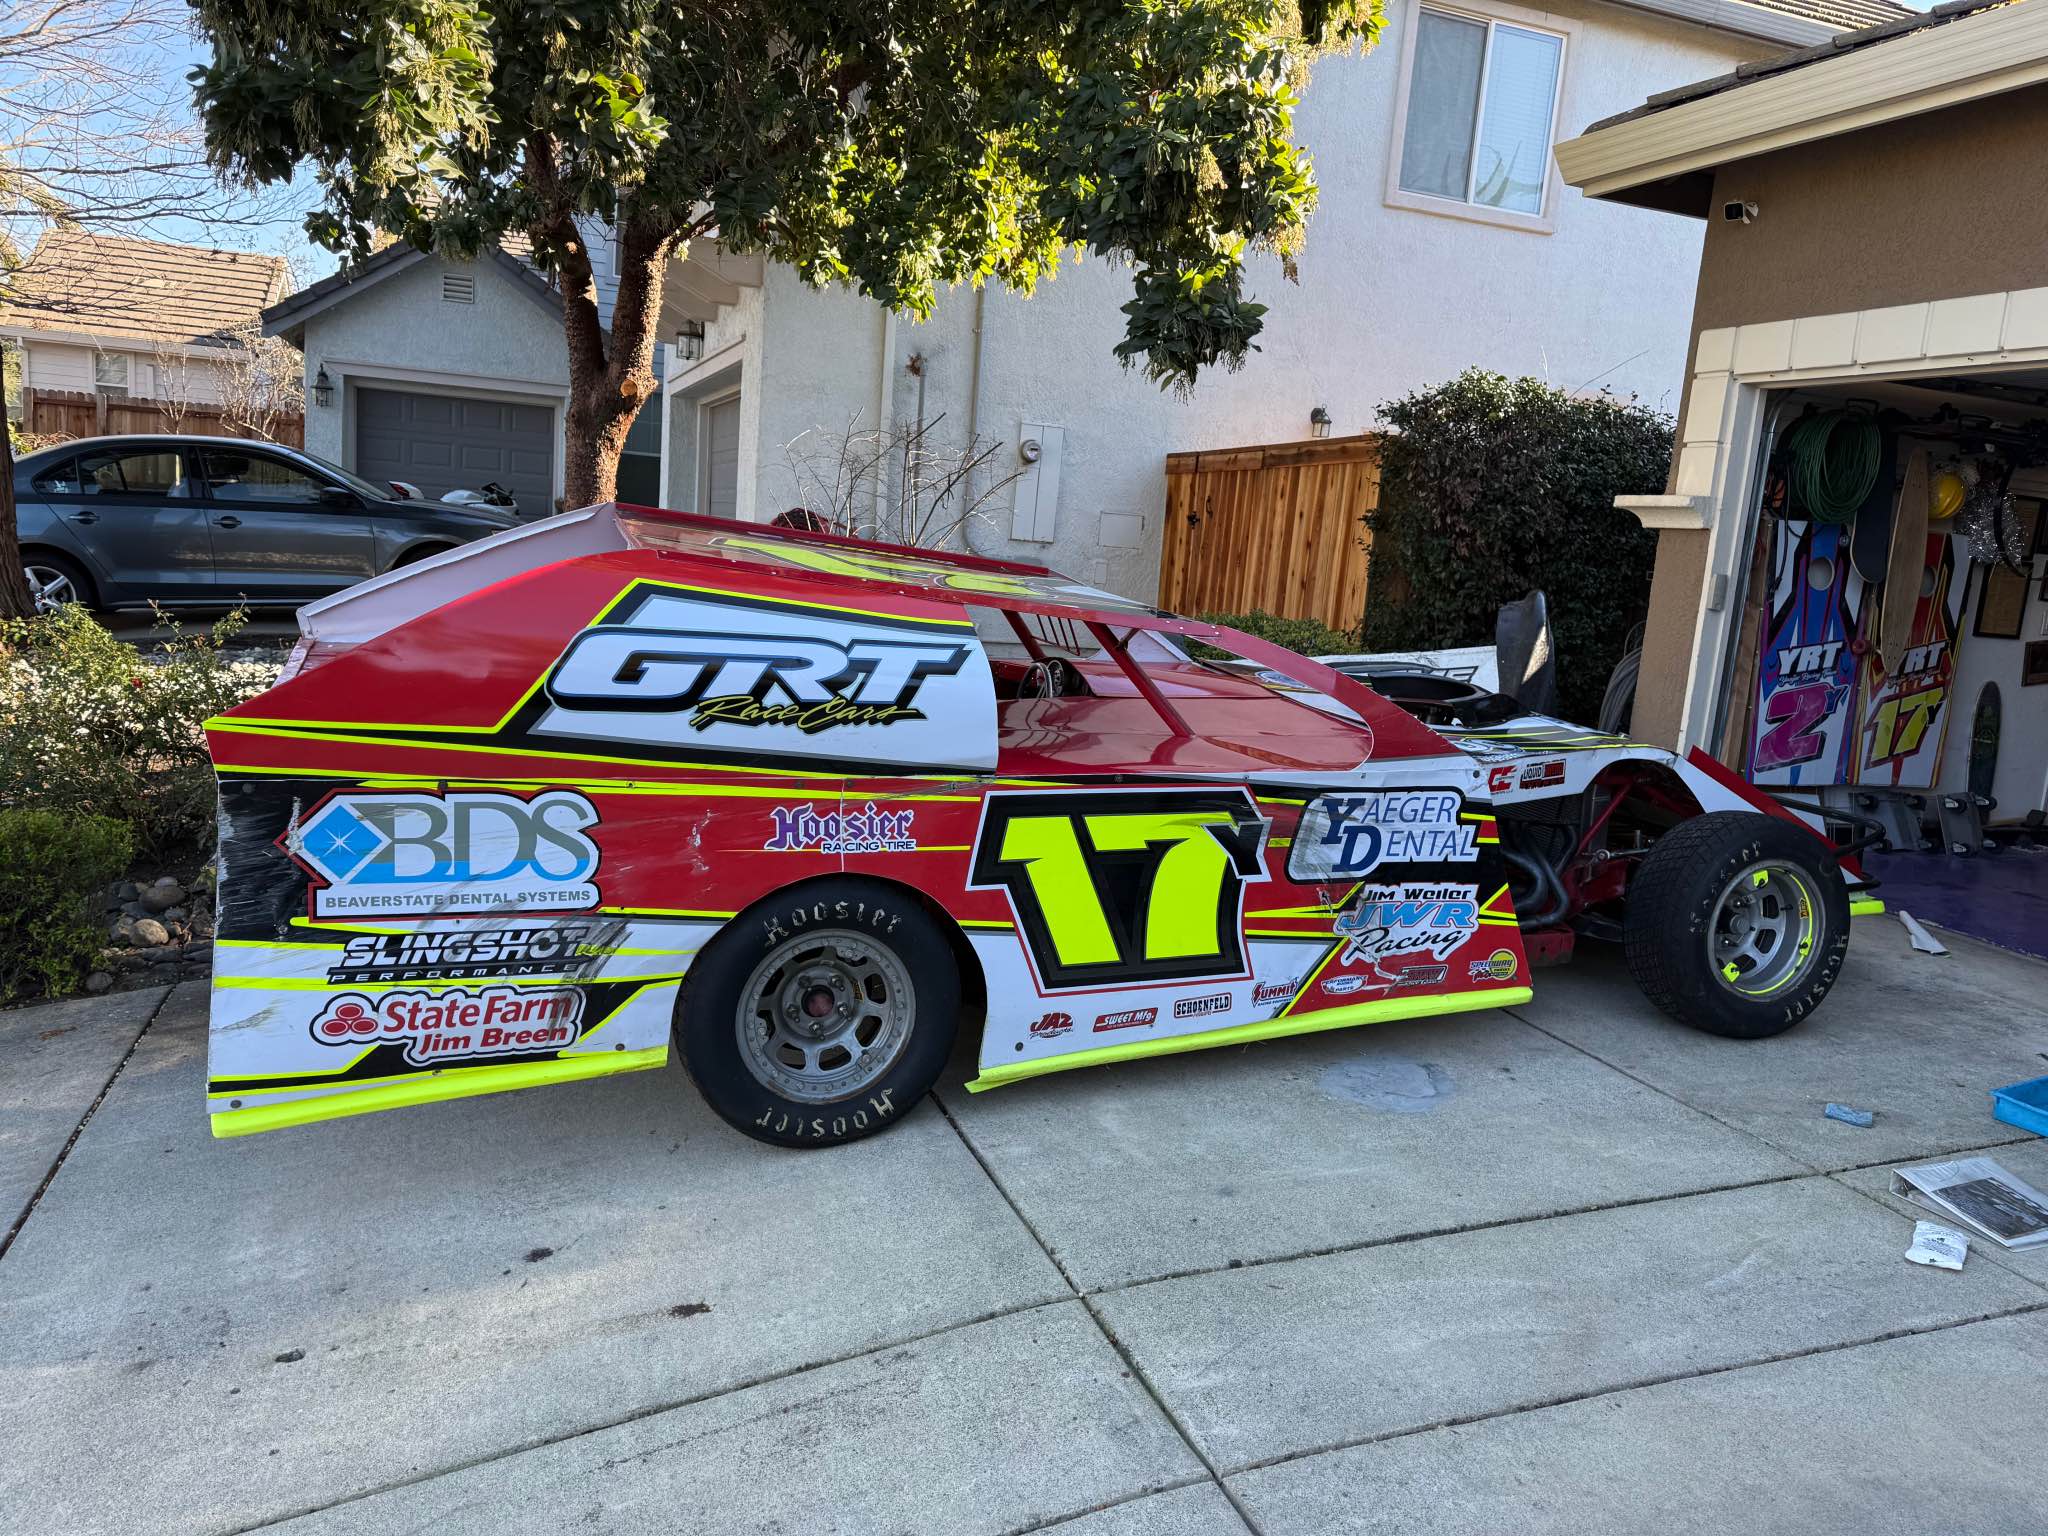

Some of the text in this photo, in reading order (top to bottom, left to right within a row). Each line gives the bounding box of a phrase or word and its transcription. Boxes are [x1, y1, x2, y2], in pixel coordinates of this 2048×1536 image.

[548, 631, 966, 707] GRT
[1778, 641, 1844, 676] YRT
[1888, 641, 1946, 677] RT
[692, 696, 911, 729] Race Cars
[765, 802, 914, 850] Hoosier
[1320, 796, 1457, 846] YAEGER
[352, 799, 591, 884] BDS
[821, 839, 916, 853] RACING TIRE
[1332, 826, 1475, 873] DENTAL
[325, 889, 592, 909] BEAVERSTATE DENTAL SYSTEMS
[1403, 888, 1472, 900] Weiler
[1340, 900, 1475, 929] JWR
[343, 928, 590, 967] SLINGSHOT
[1346, 927, 1466, 960] Racing
[330, 962, 578, 983] PERFORMANCE
[1177, 996, 1229, 1015] SCHOENFELD
[1252, 980, 1297, 1005] SUMMIT
[384, 992, 572, 1033] State Farm
[1030, 1012, 1074, 1032] JAZ
[1103, 1012, 1133, 1025] SWEET
[1134, 1010, 1154, 1022] Mfg.
[419, 1025, 568, 1056] Jim Breen
